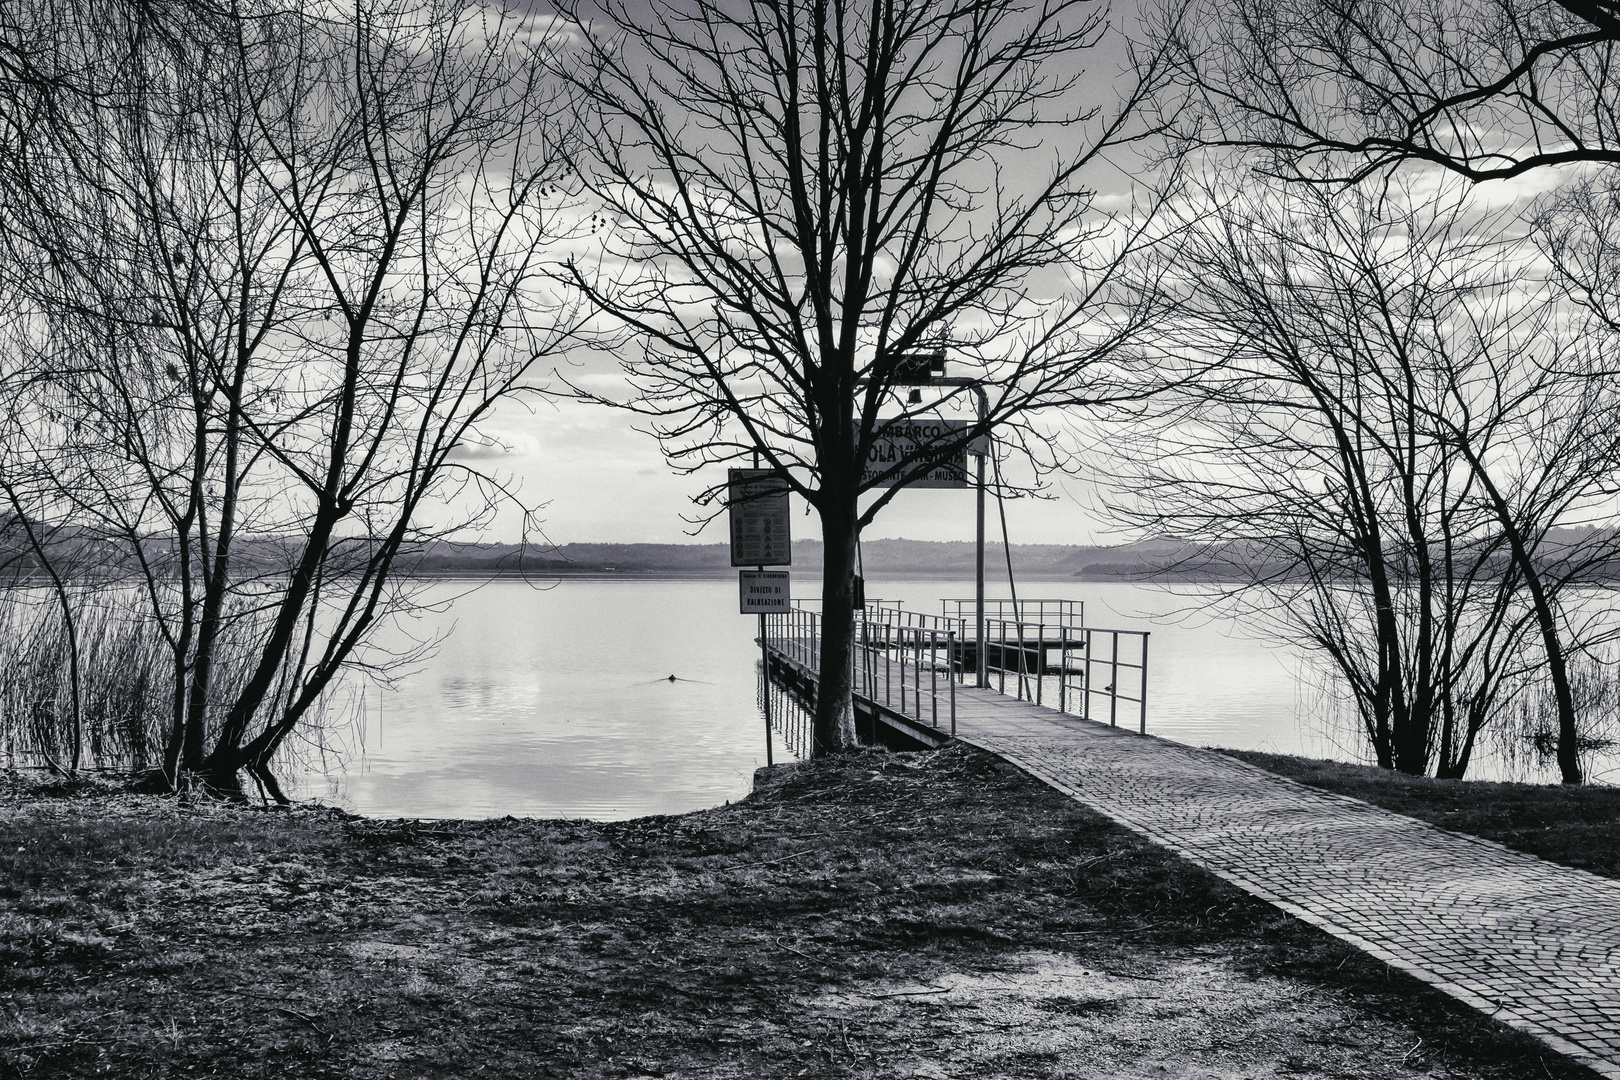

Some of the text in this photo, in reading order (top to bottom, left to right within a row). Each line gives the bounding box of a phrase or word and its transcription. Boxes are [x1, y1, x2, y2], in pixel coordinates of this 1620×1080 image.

[935, 470, 965, 481] MUSEO
[750, 586, 781, 594] DIVIETO DI
[747, 598, 785, 606] BALNEAZIONE
